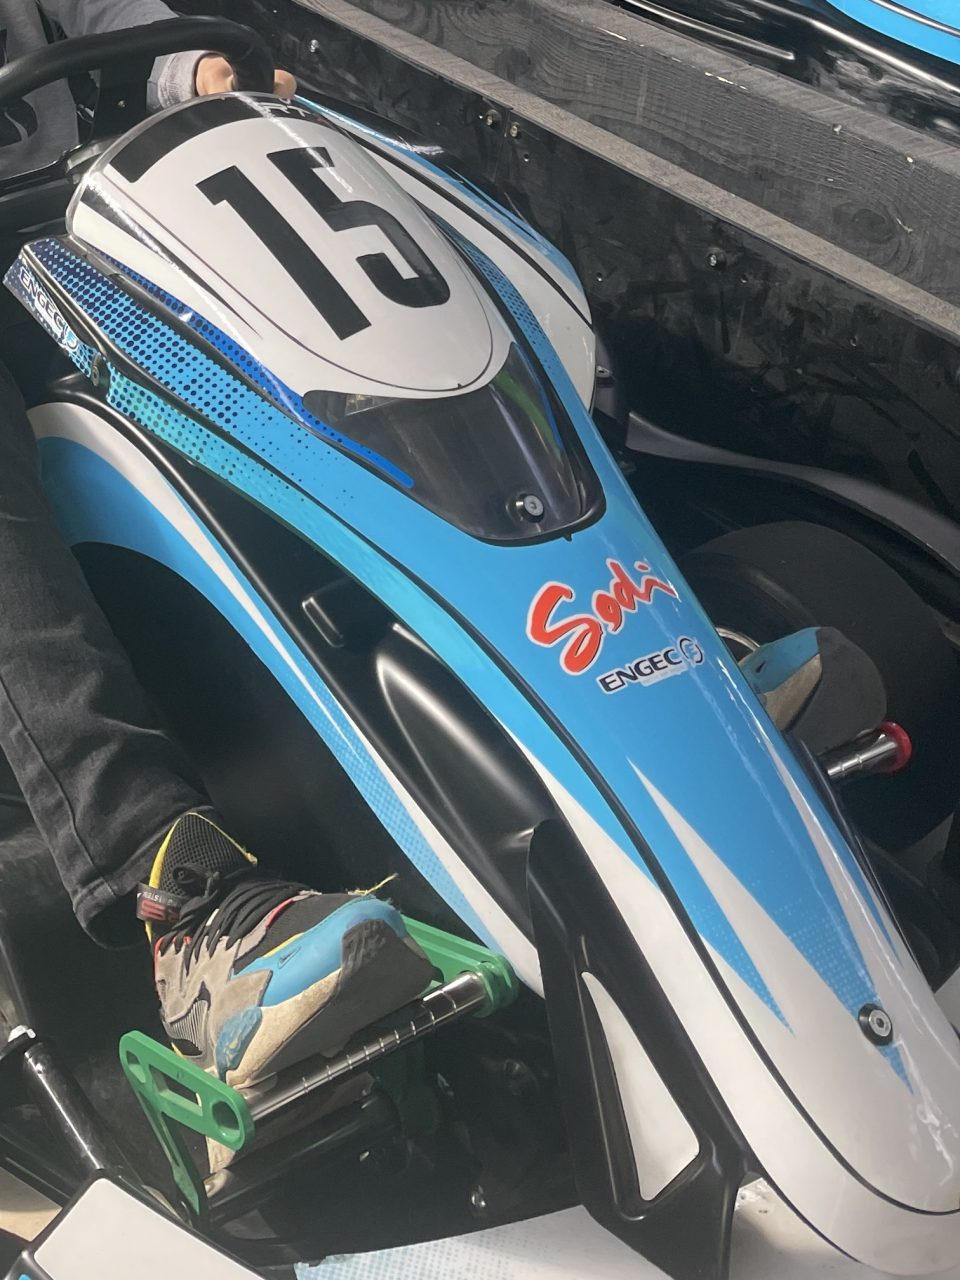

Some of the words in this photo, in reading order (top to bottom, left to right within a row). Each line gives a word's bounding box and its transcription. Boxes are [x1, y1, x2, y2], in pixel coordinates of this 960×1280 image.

[194, 146, 452, 341] 15
[19, 266, 67, 333] ENGEC
[529, 560, 678, 673] Sodi
[597, 648, 684, 693] ENGEC
